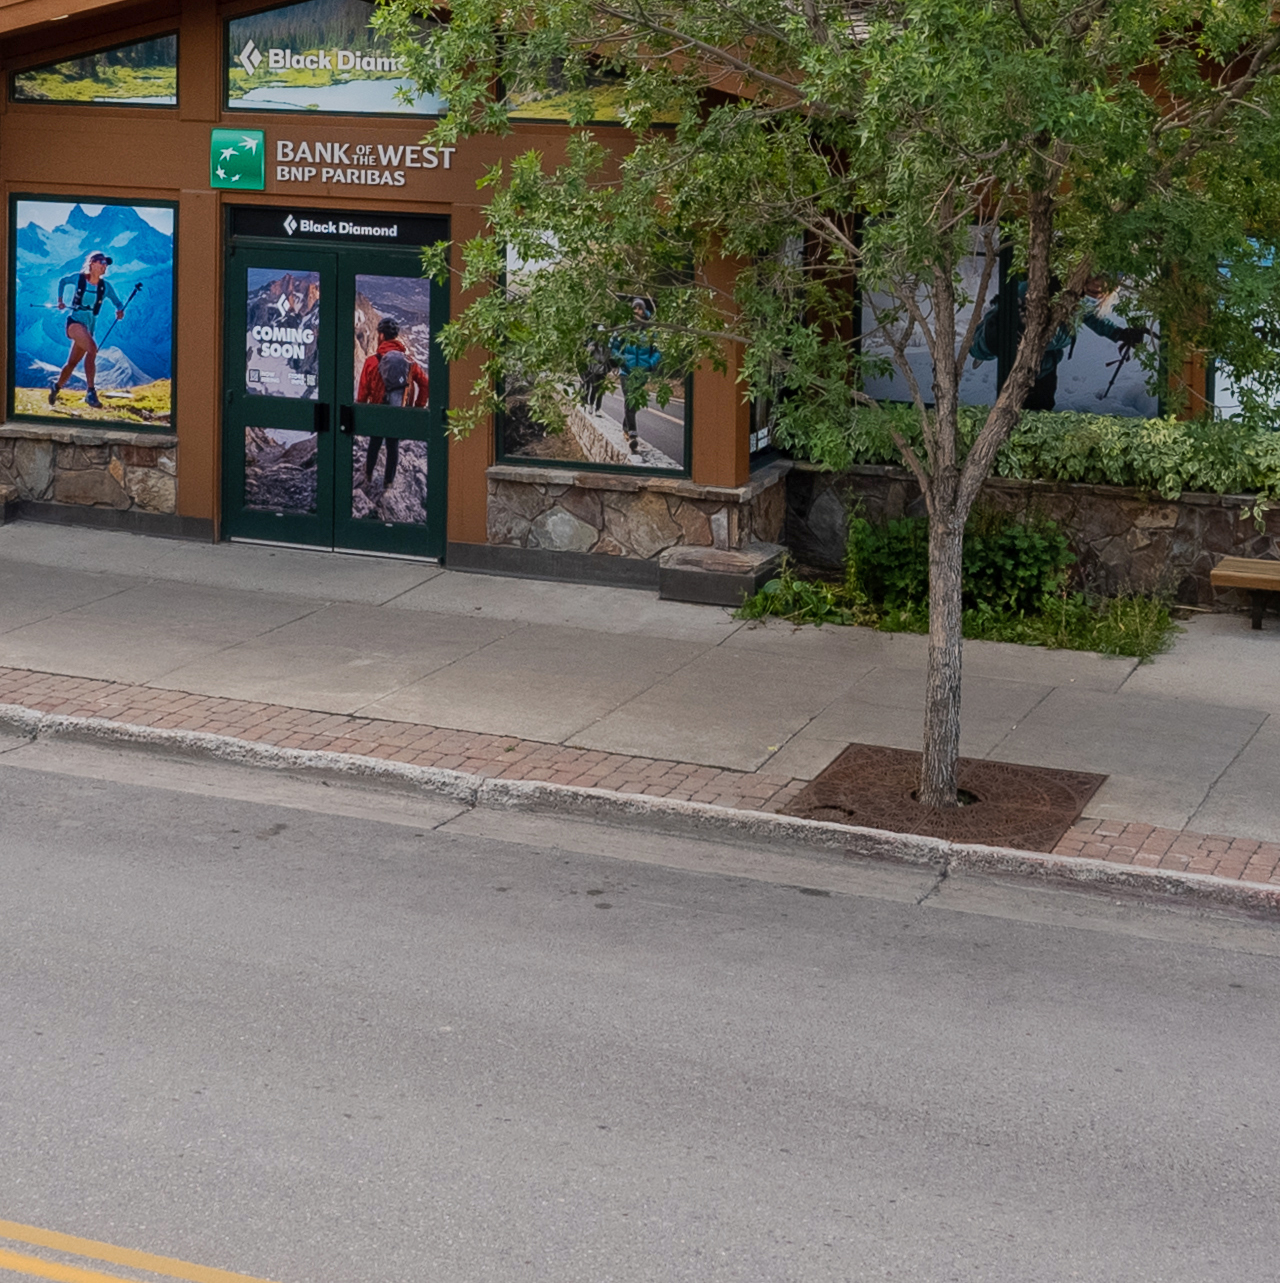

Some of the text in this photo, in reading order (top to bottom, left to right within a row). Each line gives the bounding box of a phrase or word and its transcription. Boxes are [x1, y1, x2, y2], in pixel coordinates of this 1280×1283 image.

[269, 49, 441, 72] Black Diamo
[276, 140, 456, 169] BANK OF THE WEST
[276, 166, 406, 186] BNP PARIBAS
[300, 219, 398, 237] Black Diamond
[252, 325, 315, 344] COMING
[260, 342, 305, 360] SOON
